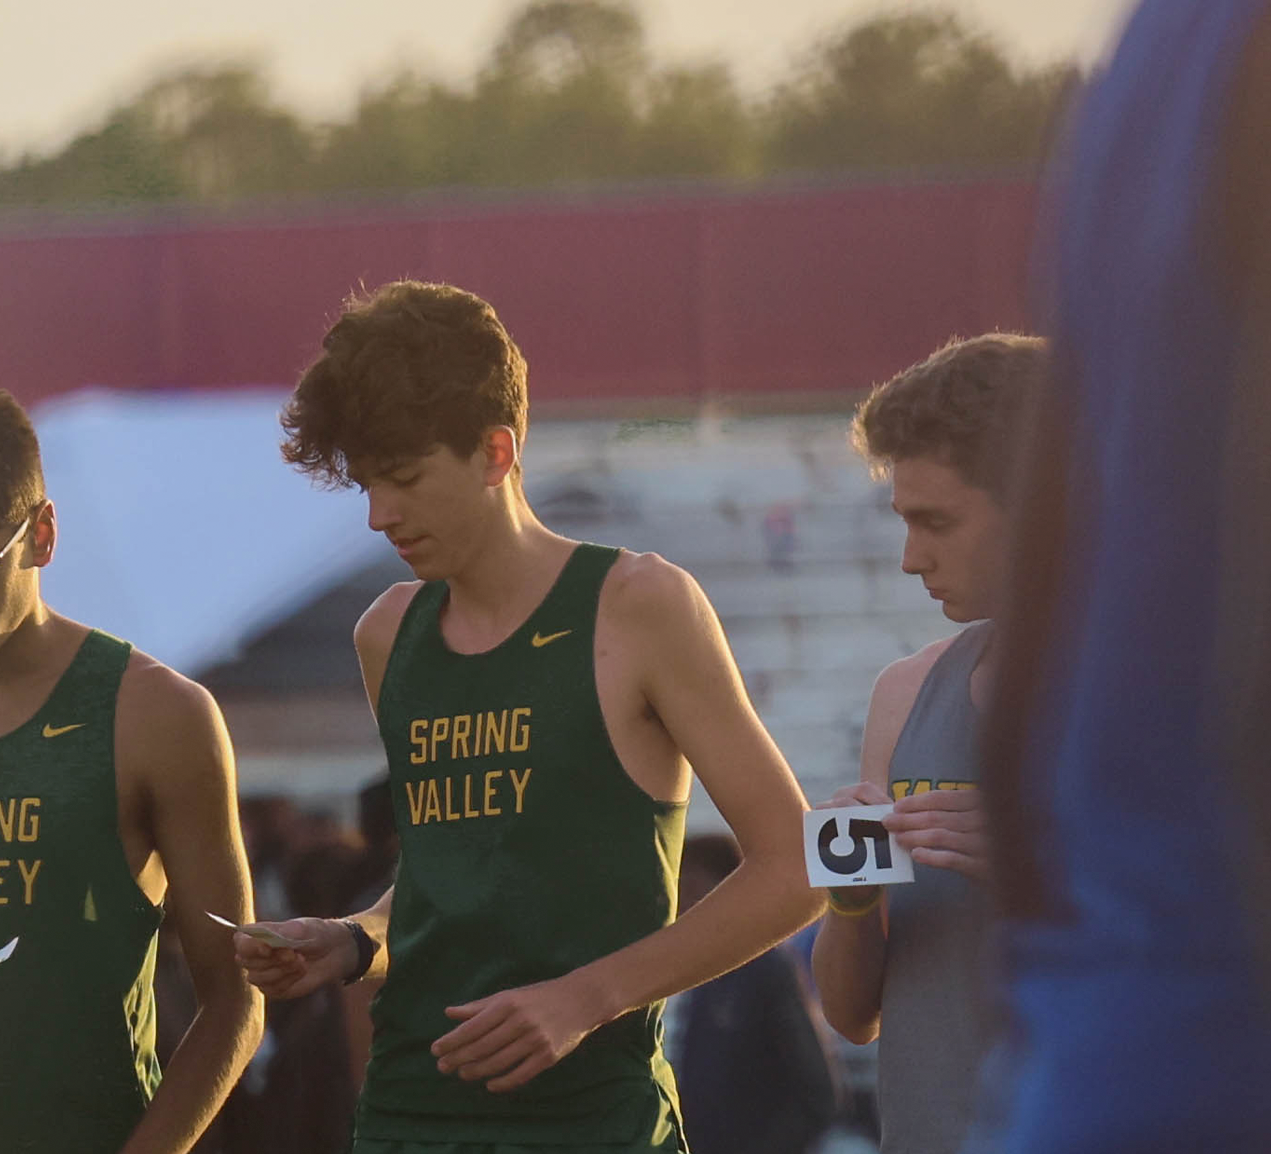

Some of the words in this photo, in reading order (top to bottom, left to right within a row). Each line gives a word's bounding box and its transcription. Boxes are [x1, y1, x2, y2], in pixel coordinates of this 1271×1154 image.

[410, 707, 532, 765] SPRING
[406, 768, 533, 825] VALLEY
[817, 816, 893, 875] 5
